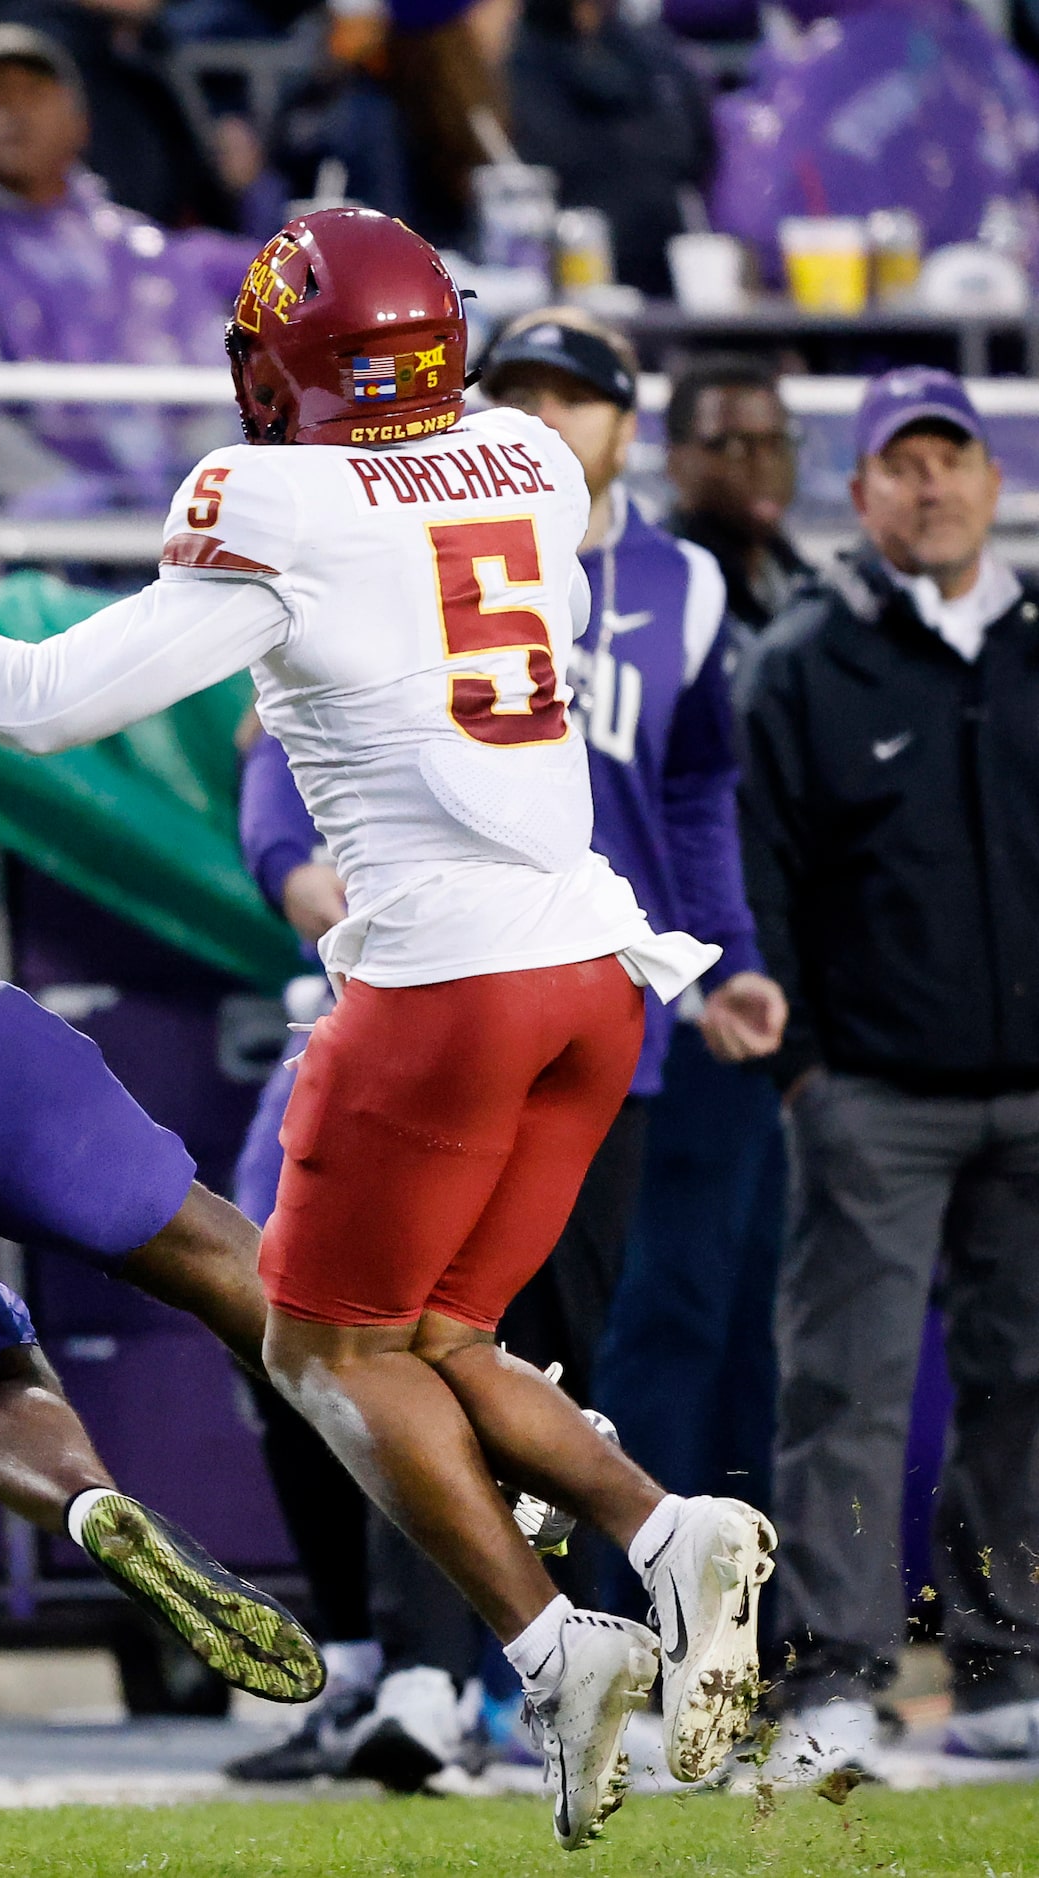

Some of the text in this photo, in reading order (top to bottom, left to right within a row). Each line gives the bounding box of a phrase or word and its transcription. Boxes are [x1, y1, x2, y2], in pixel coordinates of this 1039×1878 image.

[427, 371, 438, 388] 5
[187, 467, 232, 531] 5
[346, 443, 555, 506] PURCHASE
[423, 514, 570, 748] 5
